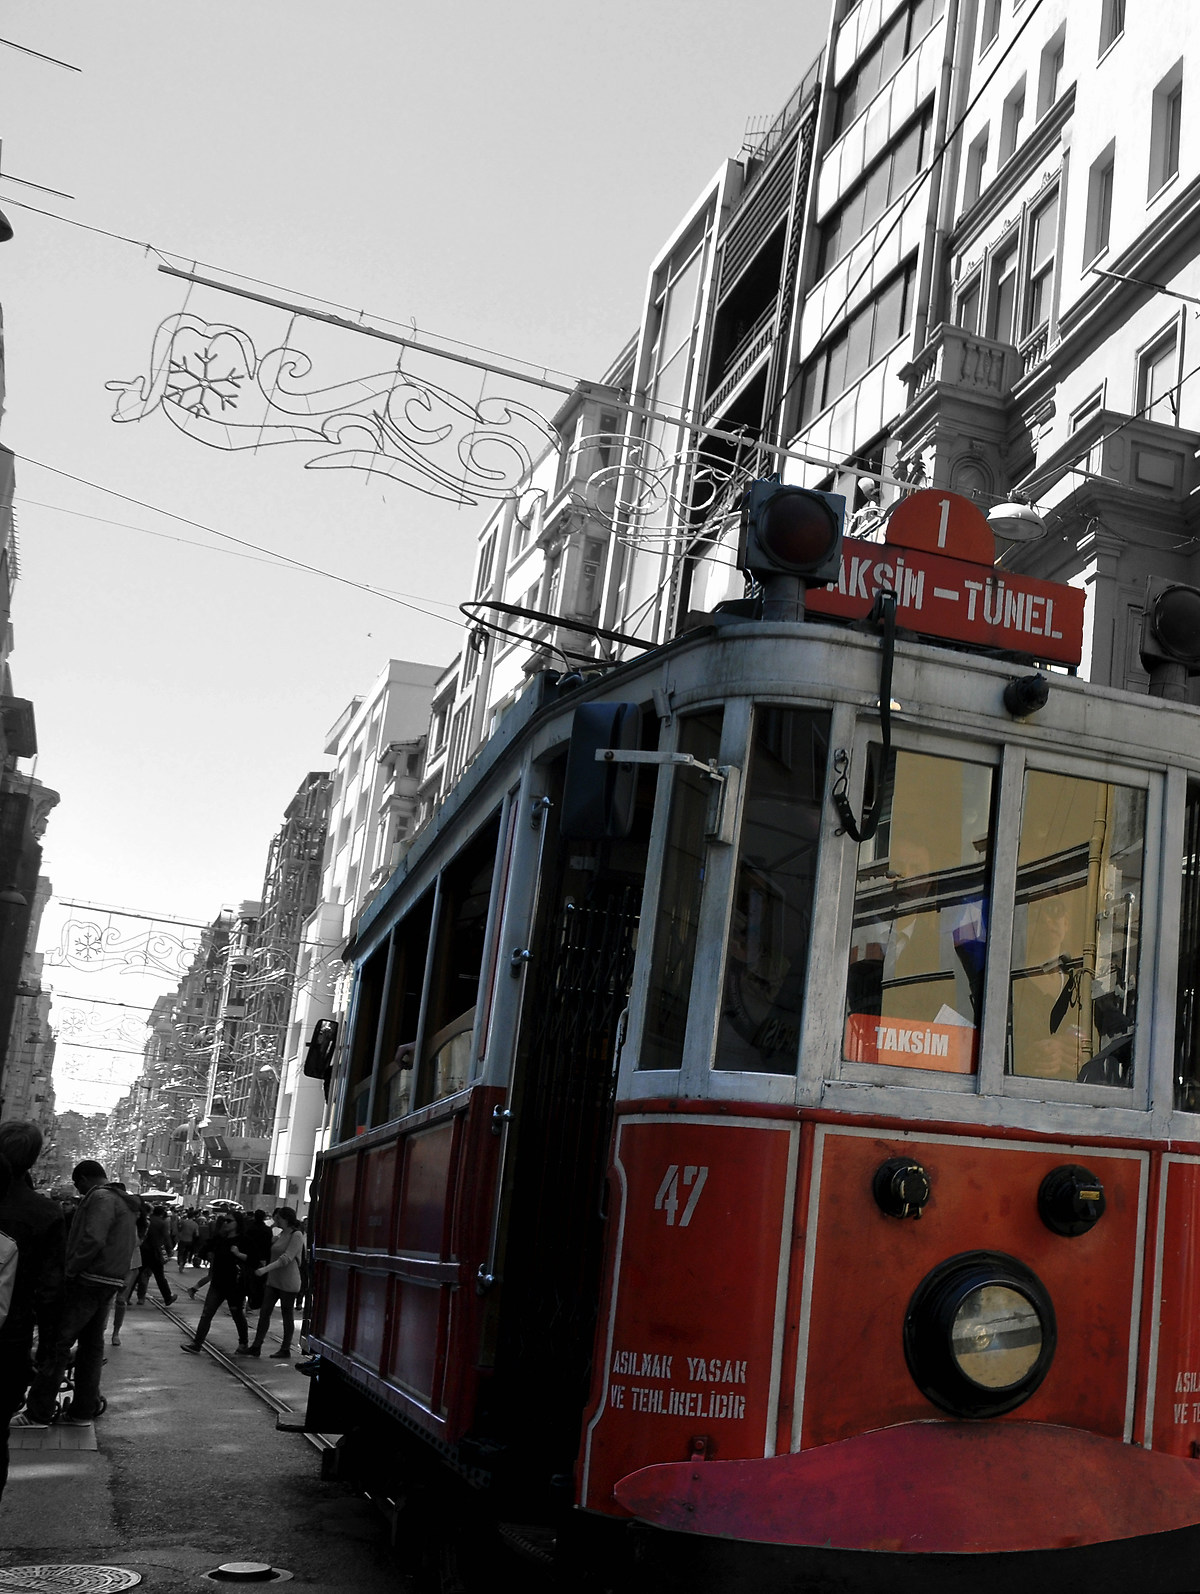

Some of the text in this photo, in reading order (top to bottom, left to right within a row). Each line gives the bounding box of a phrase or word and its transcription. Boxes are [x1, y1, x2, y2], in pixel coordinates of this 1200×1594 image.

[938, 499, 950, 549] 1
[818, 556, 925, 610] AKSİM
[964, 577, 1063, 640] TÜNEL
[874, 1026, 949, 1057] TAKSİM
[654, 1164, 709, 1227] 47
[613, 1350, 748, 1384] ASILMAK YASAK
[611, 1384, 747, 1420] VE TEHLİKELİDİR
[1173, 1403, 1189, 1424] VE
